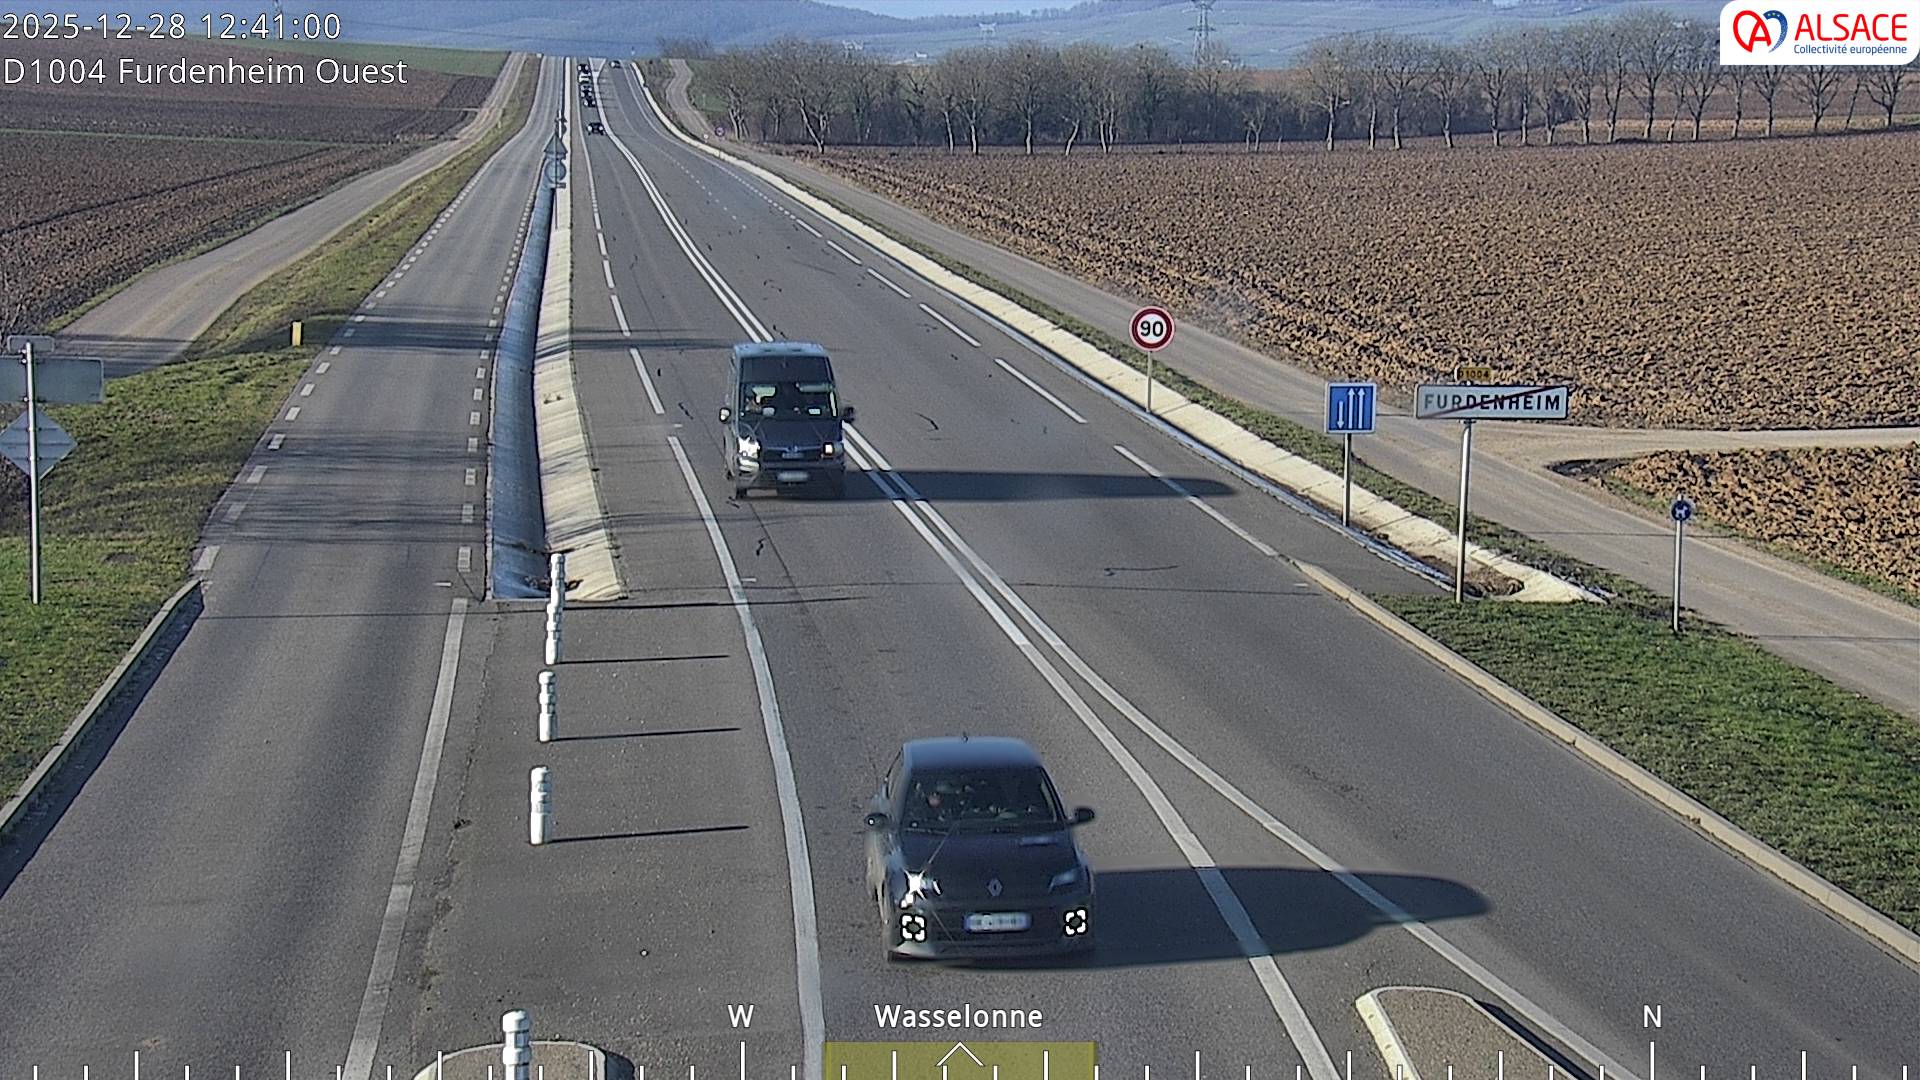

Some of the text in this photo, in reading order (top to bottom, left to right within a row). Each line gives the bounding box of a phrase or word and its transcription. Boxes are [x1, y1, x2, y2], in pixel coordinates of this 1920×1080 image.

[1140, 320, 1164, 337] 90
[1458, 367, 1490, 379] D1004
[1424, 394, 1560, 411] FURDENHEIM
